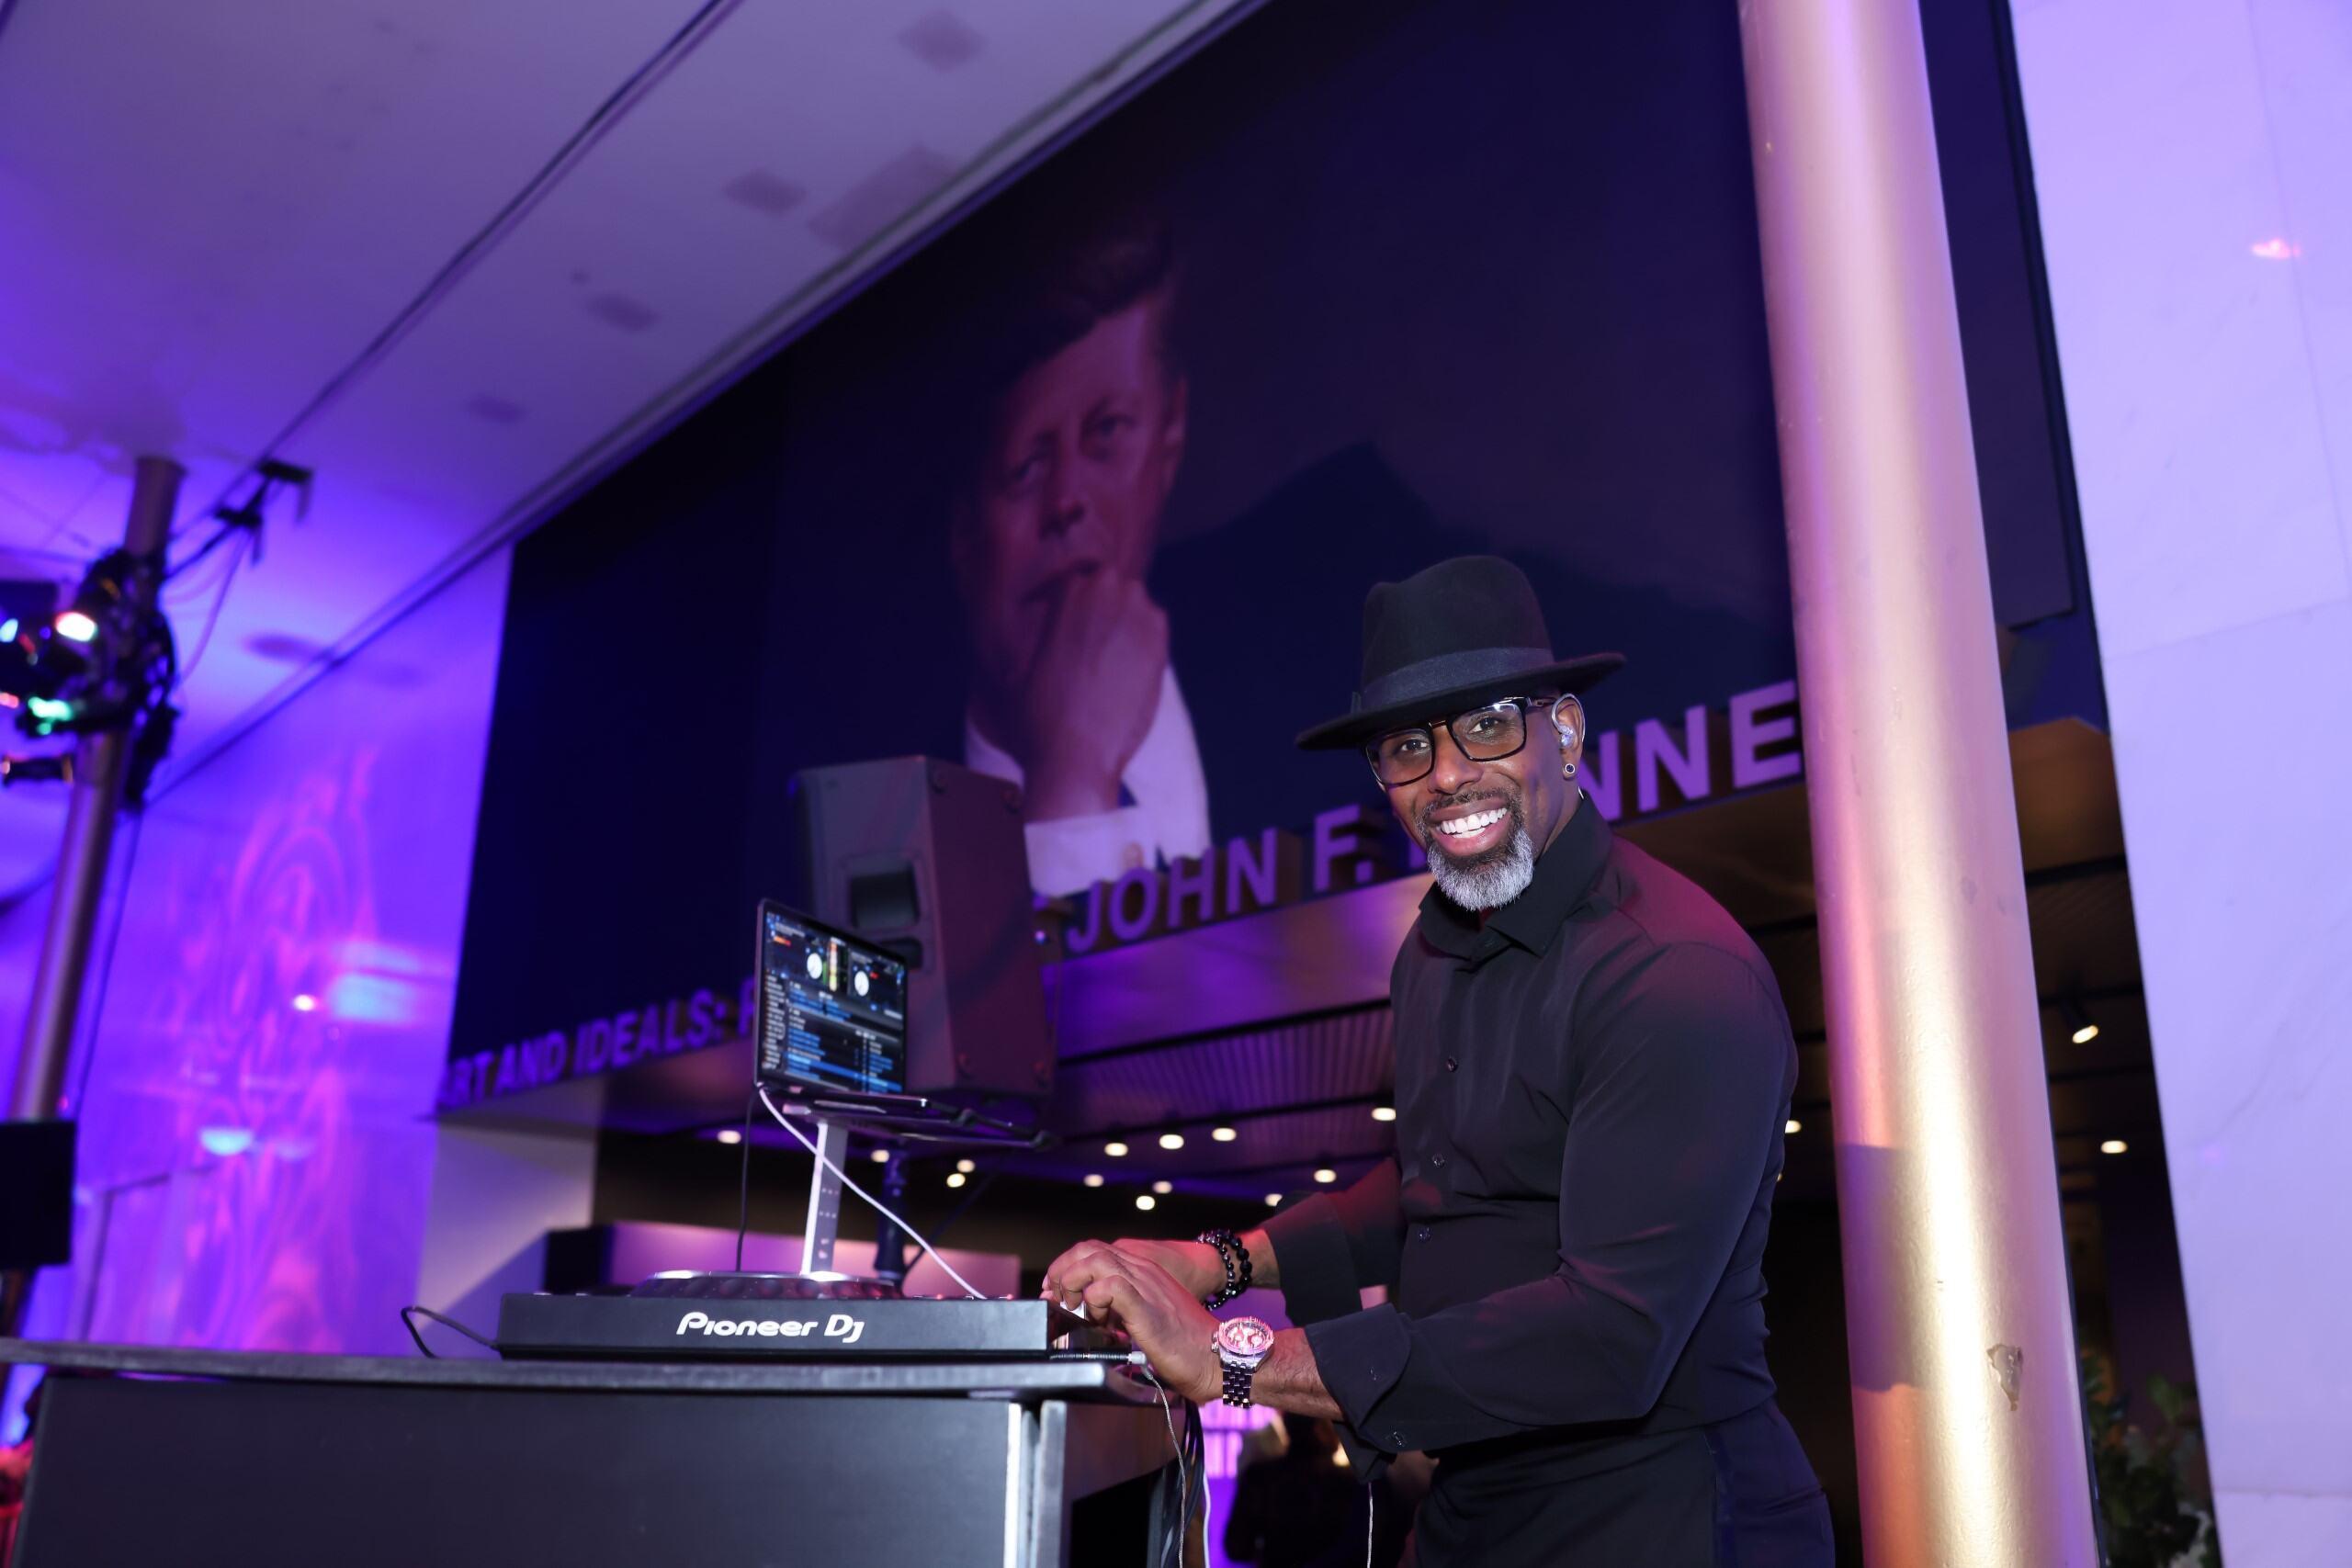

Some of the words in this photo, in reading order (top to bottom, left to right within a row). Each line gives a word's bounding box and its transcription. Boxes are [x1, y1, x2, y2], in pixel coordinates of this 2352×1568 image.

[444, 1051, 494, 1107] RT
[496, 1030, 567, 1095] AND
[572, 987, 727, 1074] IDEALS:
[1065, 827, 1279, 954] JOHN
[1313, 804, 1374, 892] F.
[676, 1311, 819, 1337] Pioneer
